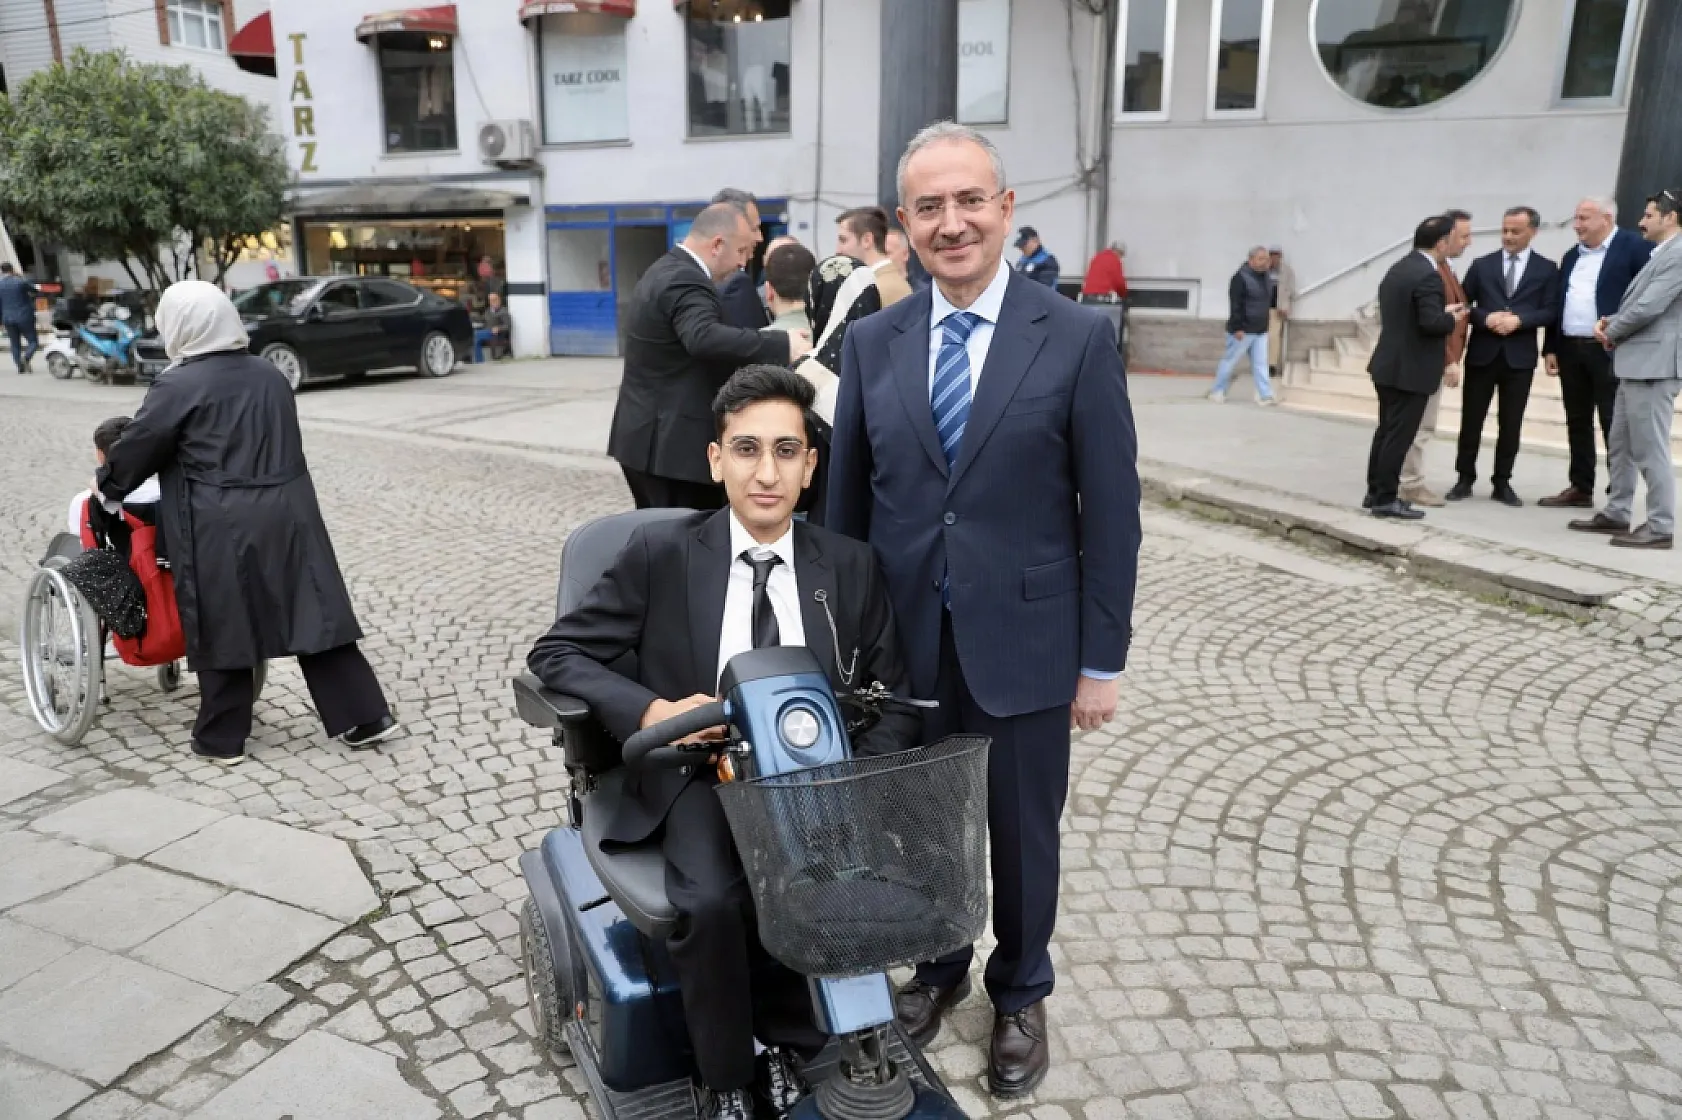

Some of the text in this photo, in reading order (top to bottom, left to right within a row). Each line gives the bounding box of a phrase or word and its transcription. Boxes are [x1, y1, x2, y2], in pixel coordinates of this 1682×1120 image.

[958, 41, 993, 56] OOL
[553, 69, 620, 86] TARZ COOL
[288, 33, 318, 172] TARZ
